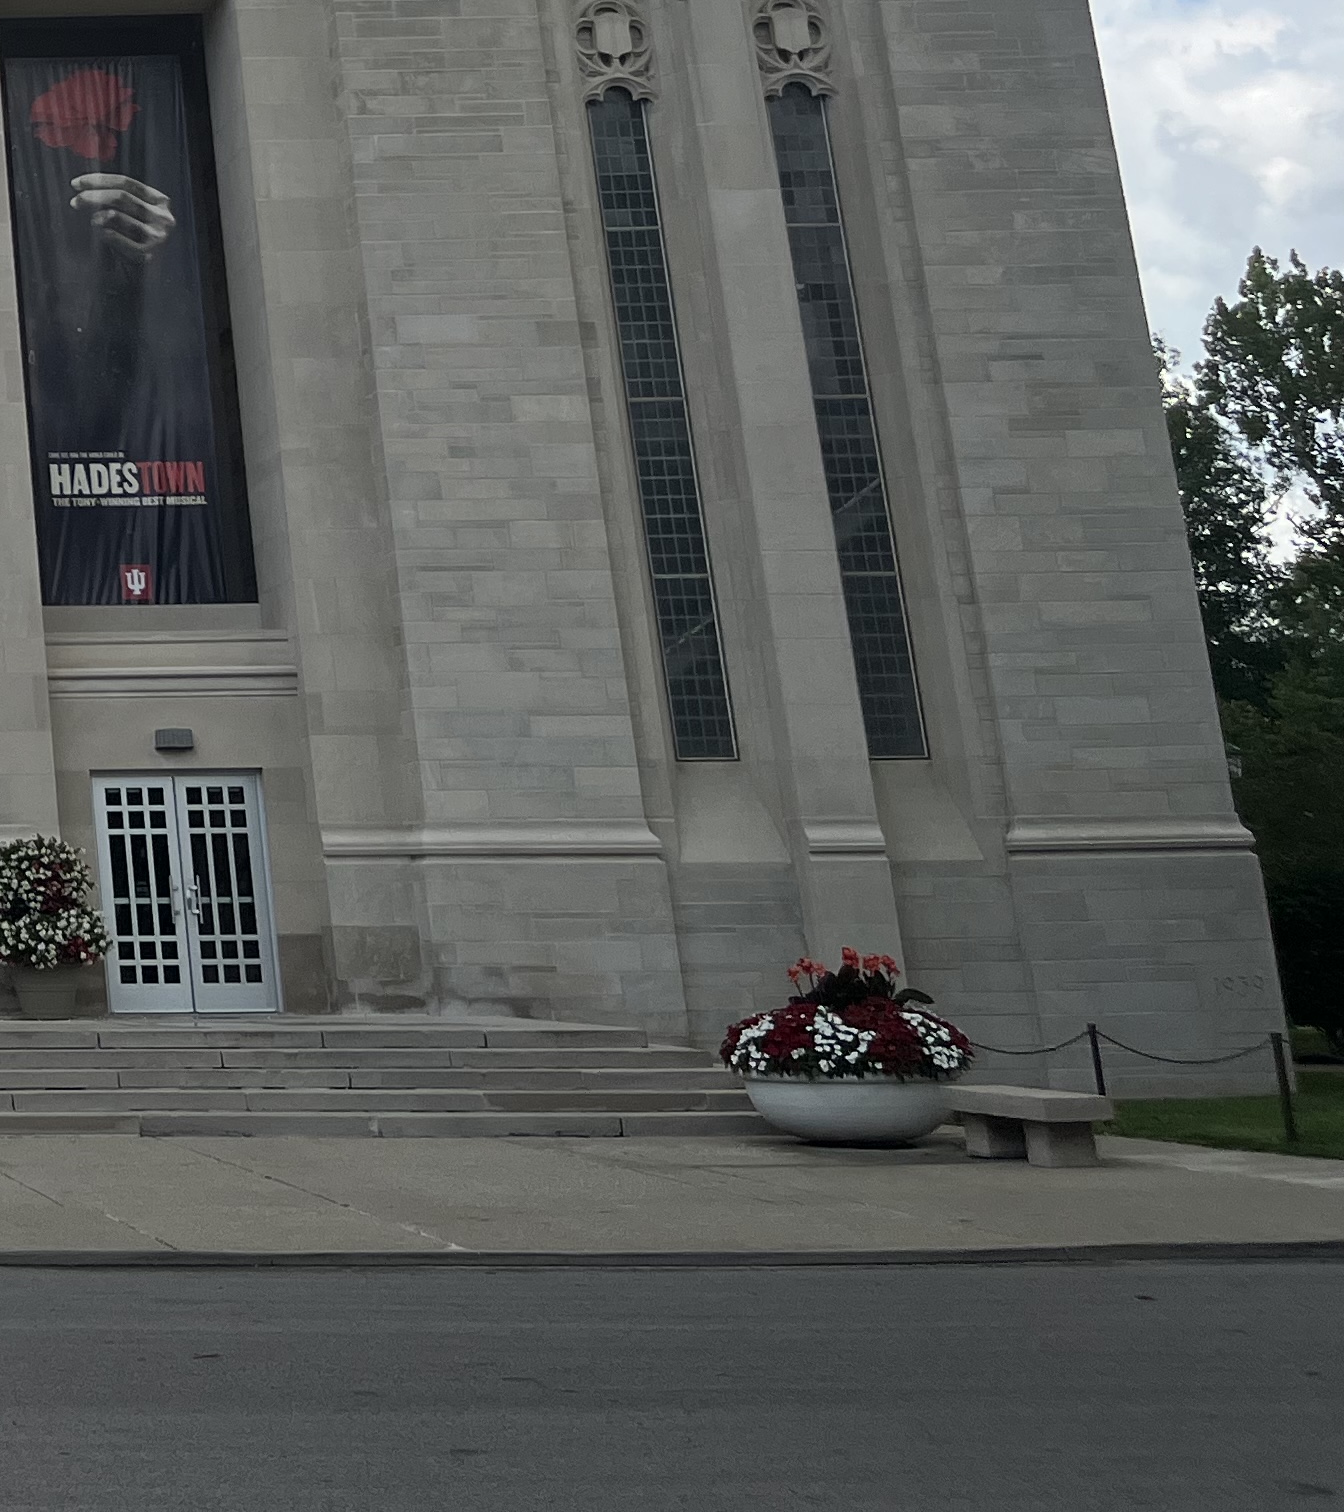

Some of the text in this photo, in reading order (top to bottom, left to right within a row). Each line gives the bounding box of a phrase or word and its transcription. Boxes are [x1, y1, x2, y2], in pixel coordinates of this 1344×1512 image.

[49, 461, 205, 495] HADESTOWN
[52, 497, 70, 507] THE
[166, 495, 208, 505] MUSICAL
